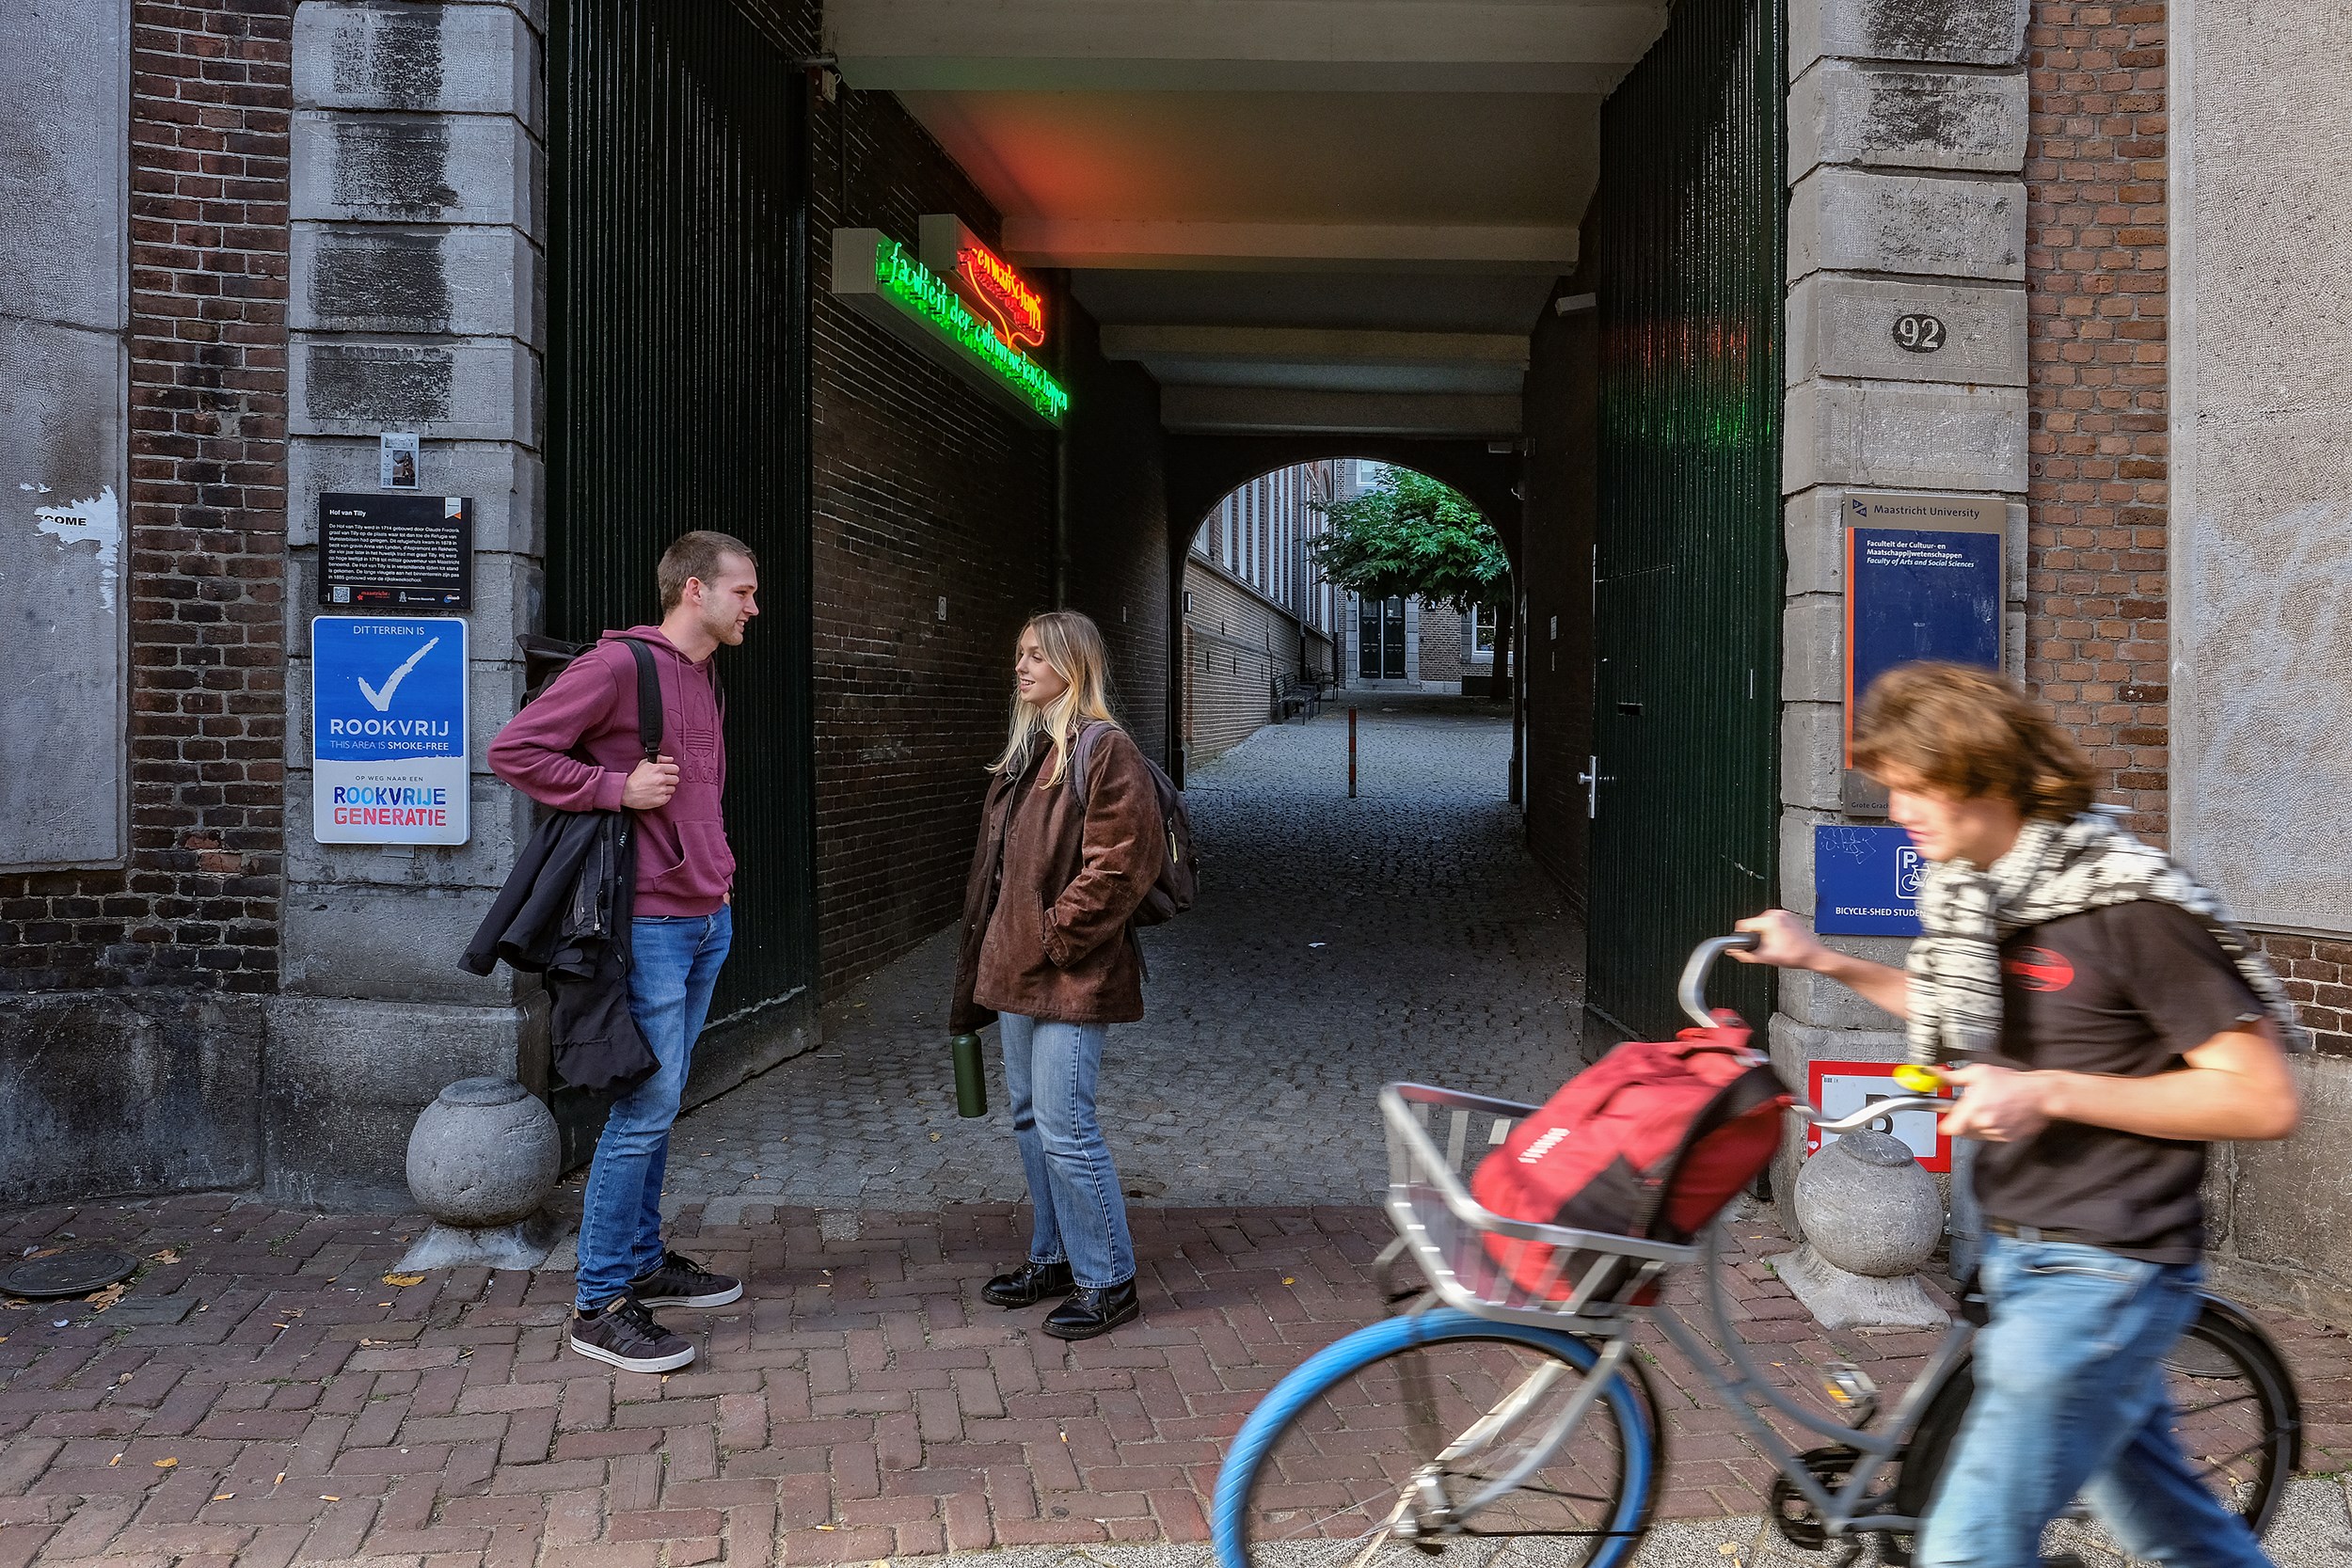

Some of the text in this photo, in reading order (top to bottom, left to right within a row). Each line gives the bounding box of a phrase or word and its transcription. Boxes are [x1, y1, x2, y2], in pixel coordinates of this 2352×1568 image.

[1900, 317, 1939, 348] 92
[1874, 505, 1980, 519] Maastricht University
[1867, 549, 1962, 559] Maatschappijwetenschappen
[353, 626, 424, 635] DIT TERREIN IS
[331, 719, 449, 736] ROOKVRIJ
[330, 740, 449, 751] THIS AREA IS SMOKE-FREE
[679, 760, 719, 785] didas
[334, 787, 446, 806] ROOKVRIJE
[334, 808, 446, 826] GENERATIE
[1903, 851, 1917, 868] P
[1836, 907, 1892, 916] BICYCLE-SHED
